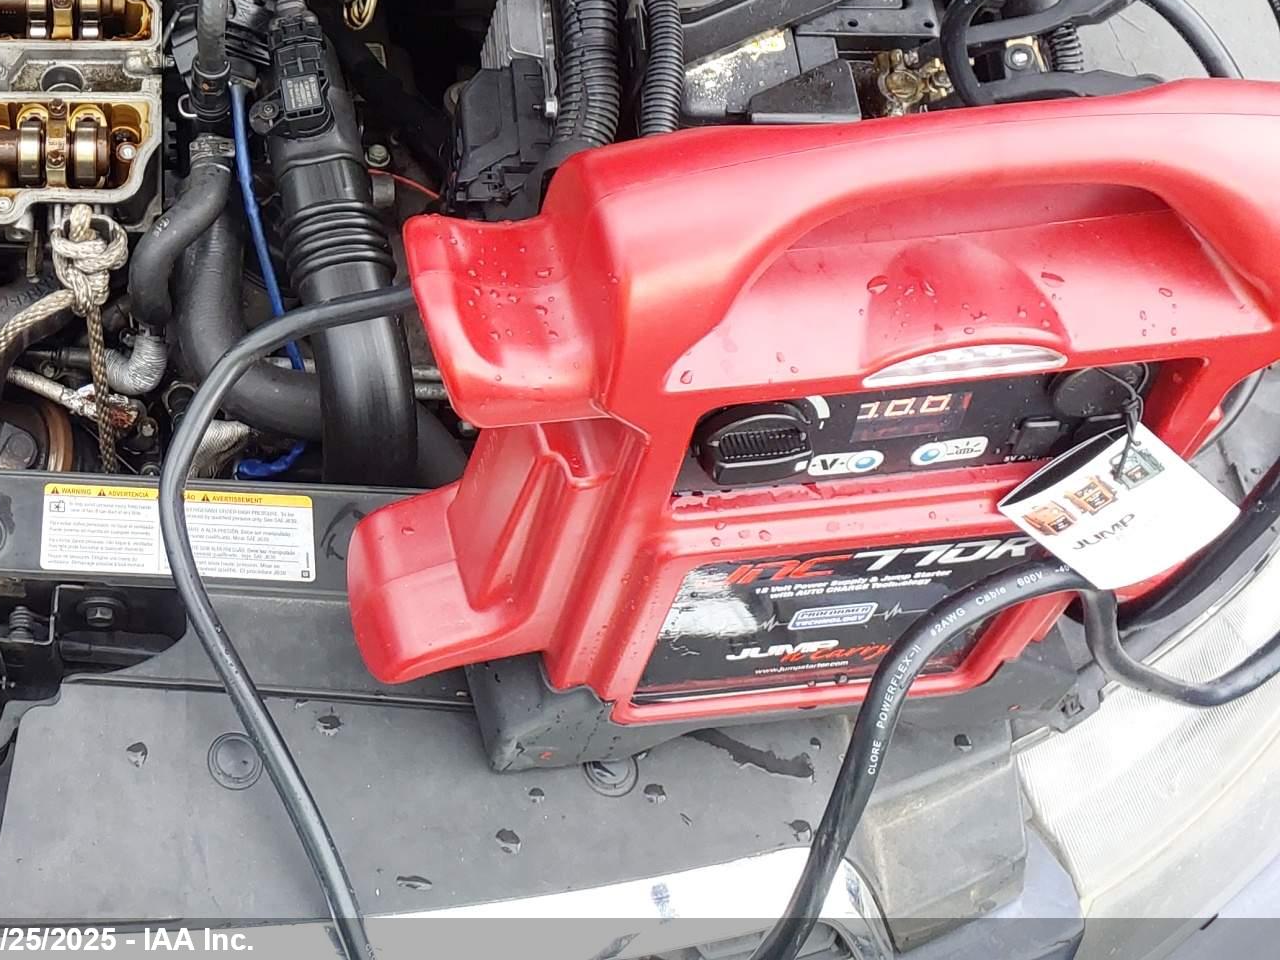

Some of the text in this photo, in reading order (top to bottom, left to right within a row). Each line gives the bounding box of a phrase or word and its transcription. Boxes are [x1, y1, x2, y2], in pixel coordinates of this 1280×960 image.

[61, 487, 149, 498] WARNING ADVERTENCIA
[212, 495, 263, 504] AVERTISSEMENT
[1072, 513, 1136, 551] JUMP
[770, 578, 933, 600] with AUTO CHARGE Technology
[771, 585, 793, 593] Volt
[793, 582, 829, 591] Power
[830, 577, 868, 588] Supply
[880, 574, 912, 583] Jump
[913, 570, 953, 579] Starter
[725, 640, 839, 661] JUMP
[867, 740, 883, 775] CLORE
[929, 607, 966, 638] #2AWG
[975, 585, 1007, 607] Cable
